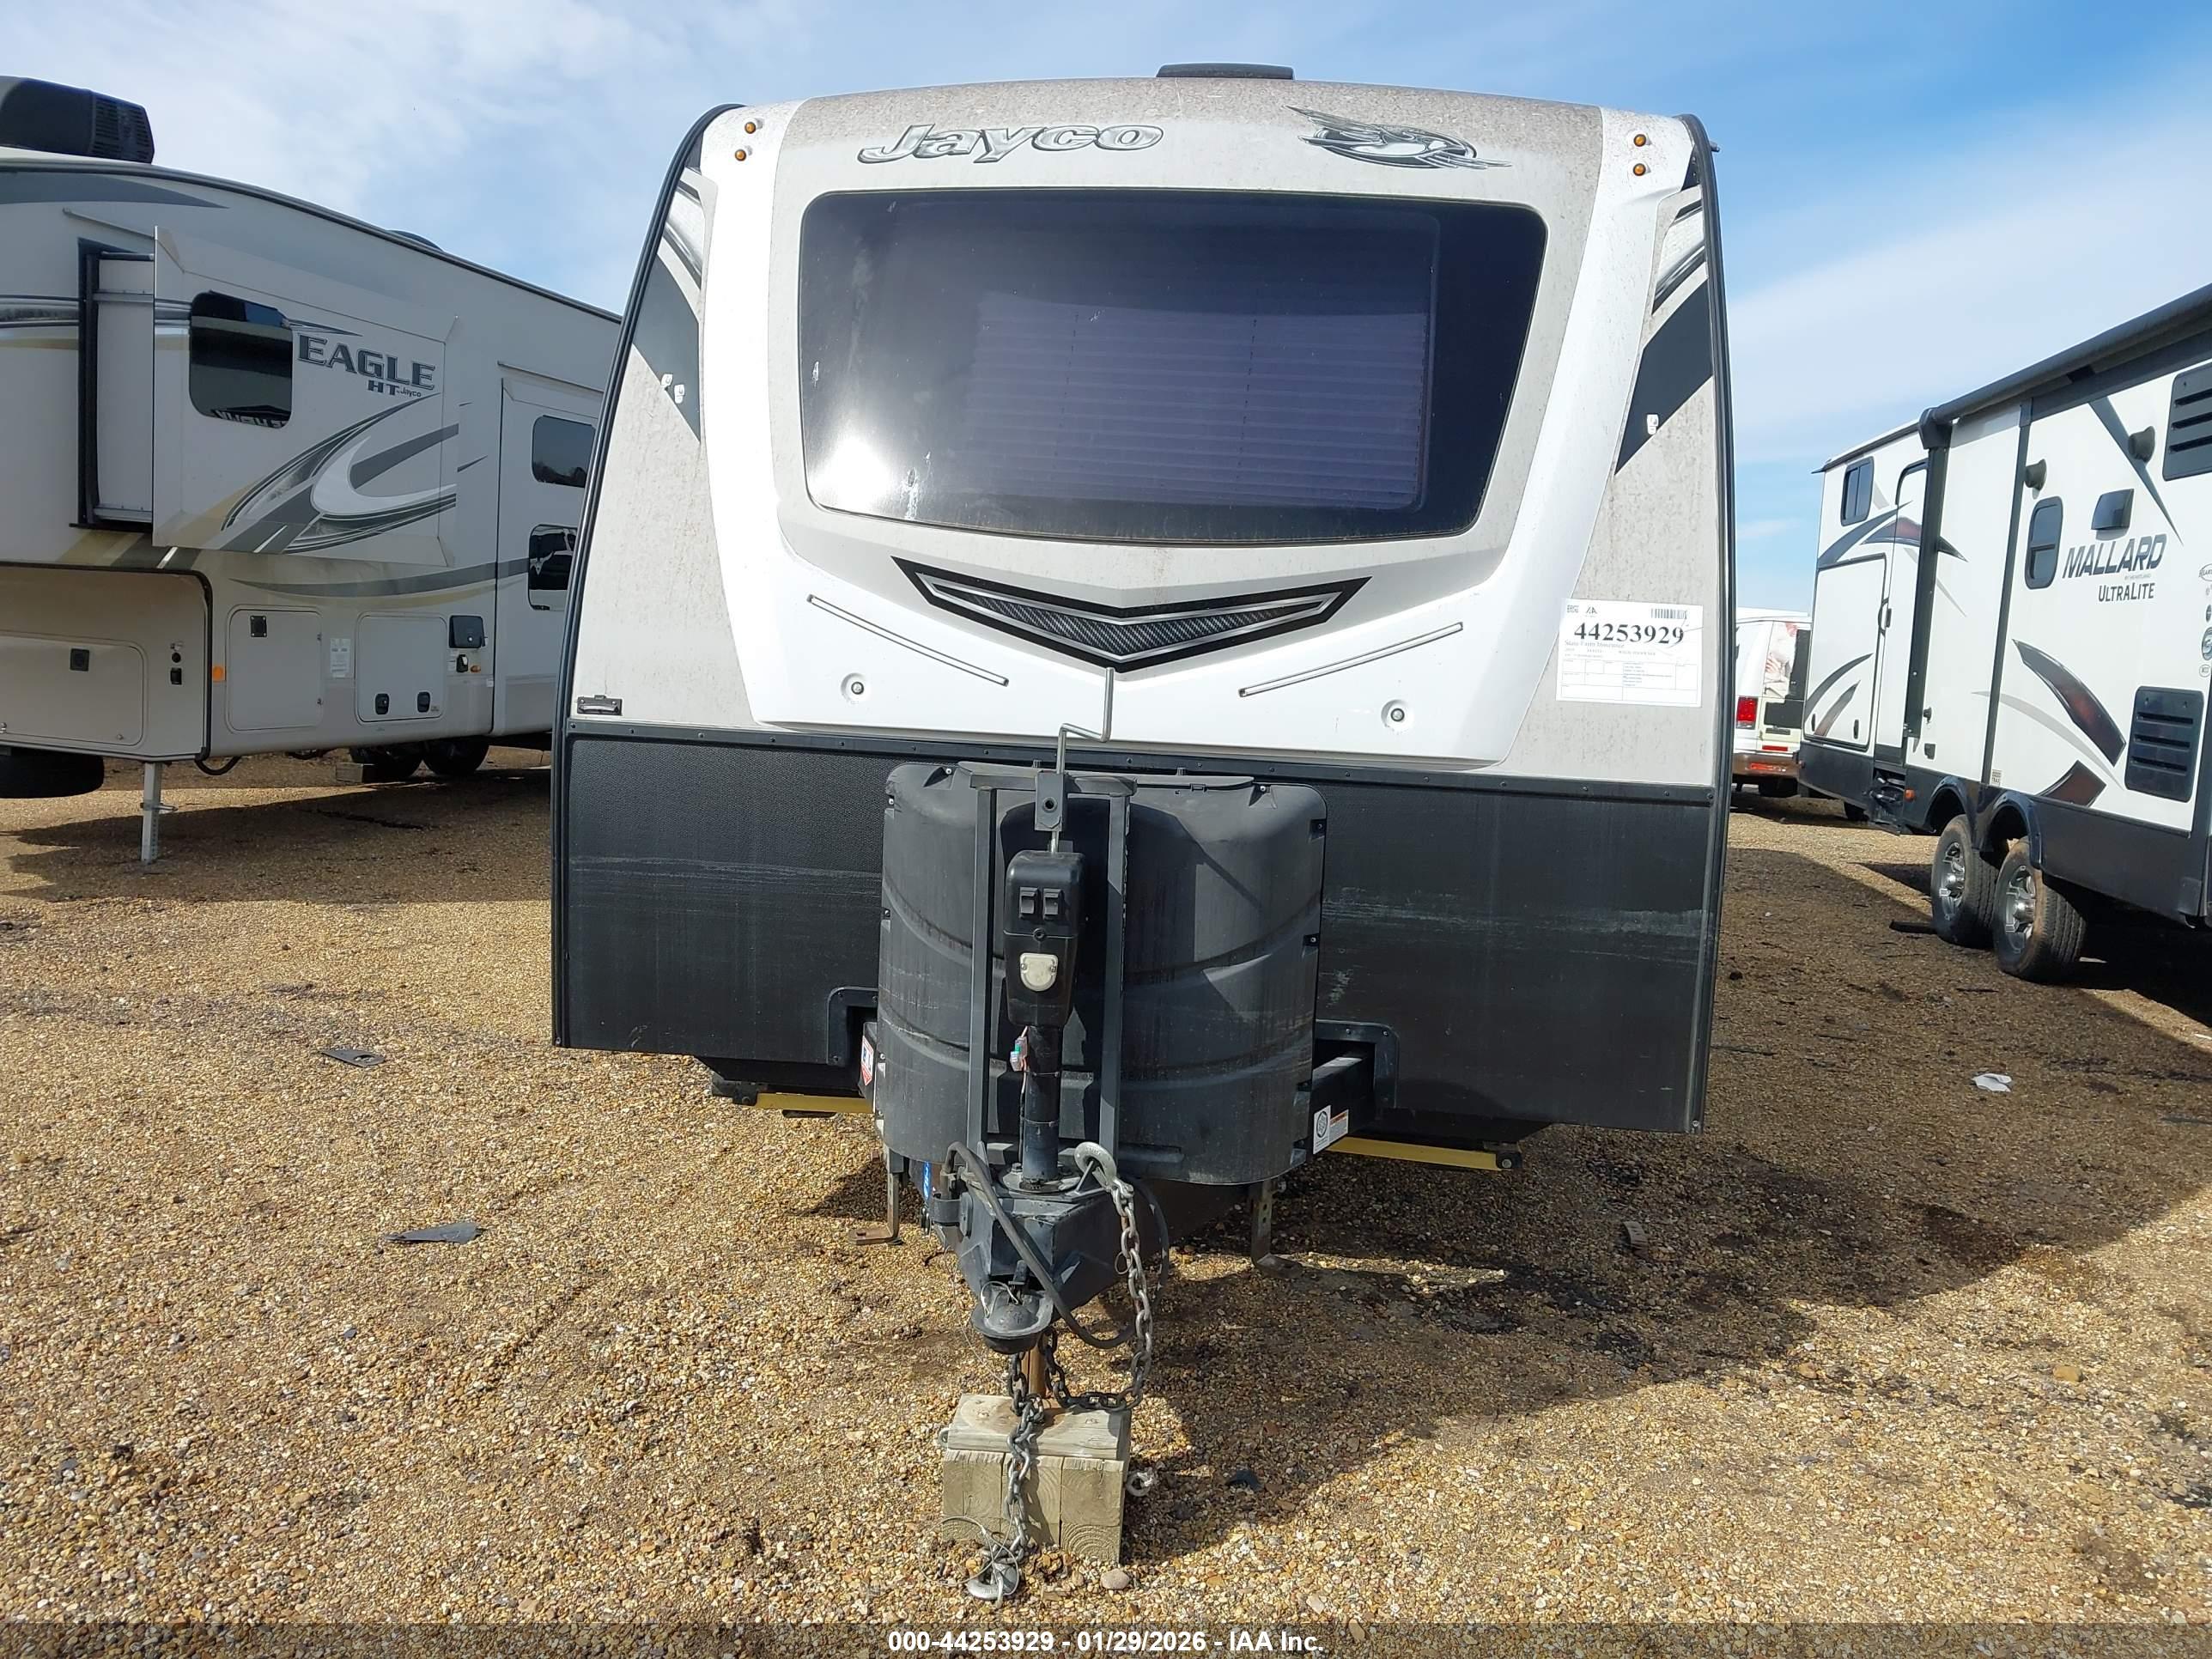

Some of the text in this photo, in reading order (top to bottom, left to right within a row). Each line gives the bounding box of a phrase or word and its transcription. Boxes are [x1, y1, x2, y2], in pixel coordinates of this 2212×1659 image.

[857, 123, 1164, 163] Jayco
[297, 333, 435, 390] EAGLE
[368, 380, 399, 396] HT
[2062, 533, 2167, 579] MALLARD
[1574, 622, 1684, 645] 44253929
